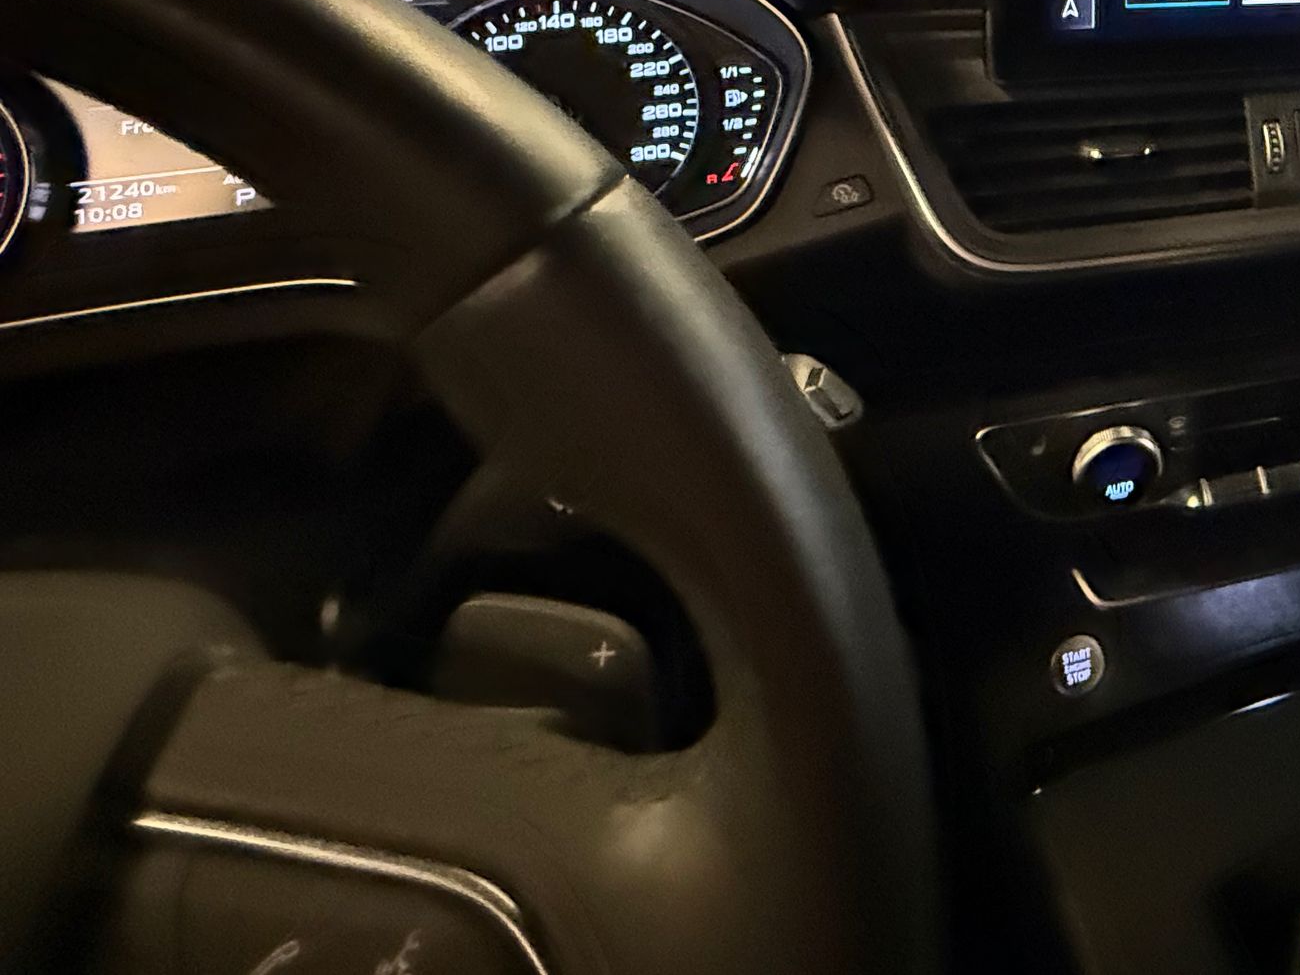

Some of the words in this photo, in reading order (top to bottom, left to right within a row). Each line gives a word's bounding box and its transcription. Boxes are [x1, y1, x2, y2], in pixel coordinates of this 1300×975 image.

[514, 20, 538, 33] 120
[538, 12, 576, 30] 140
[484, 33, 524, 53] 100
[595, 26, 633, 45] 180
[627, 42, 655, 56] 200
[630, 60, 670, 79] 220
[720, 66, 739, 79] 1/1
[653, 83, 680, 97] 240
[642, 102, 683, 121] 260
[630, 143, 671, 163] 300
[235, 187, 257, 206] P
[74, 202, 144, 226] 10:08
[1105, 480, 1134, 497] AUTO
[1062, 647, 1091, 665] START
[1066, 668, 1092, 686] STOP
